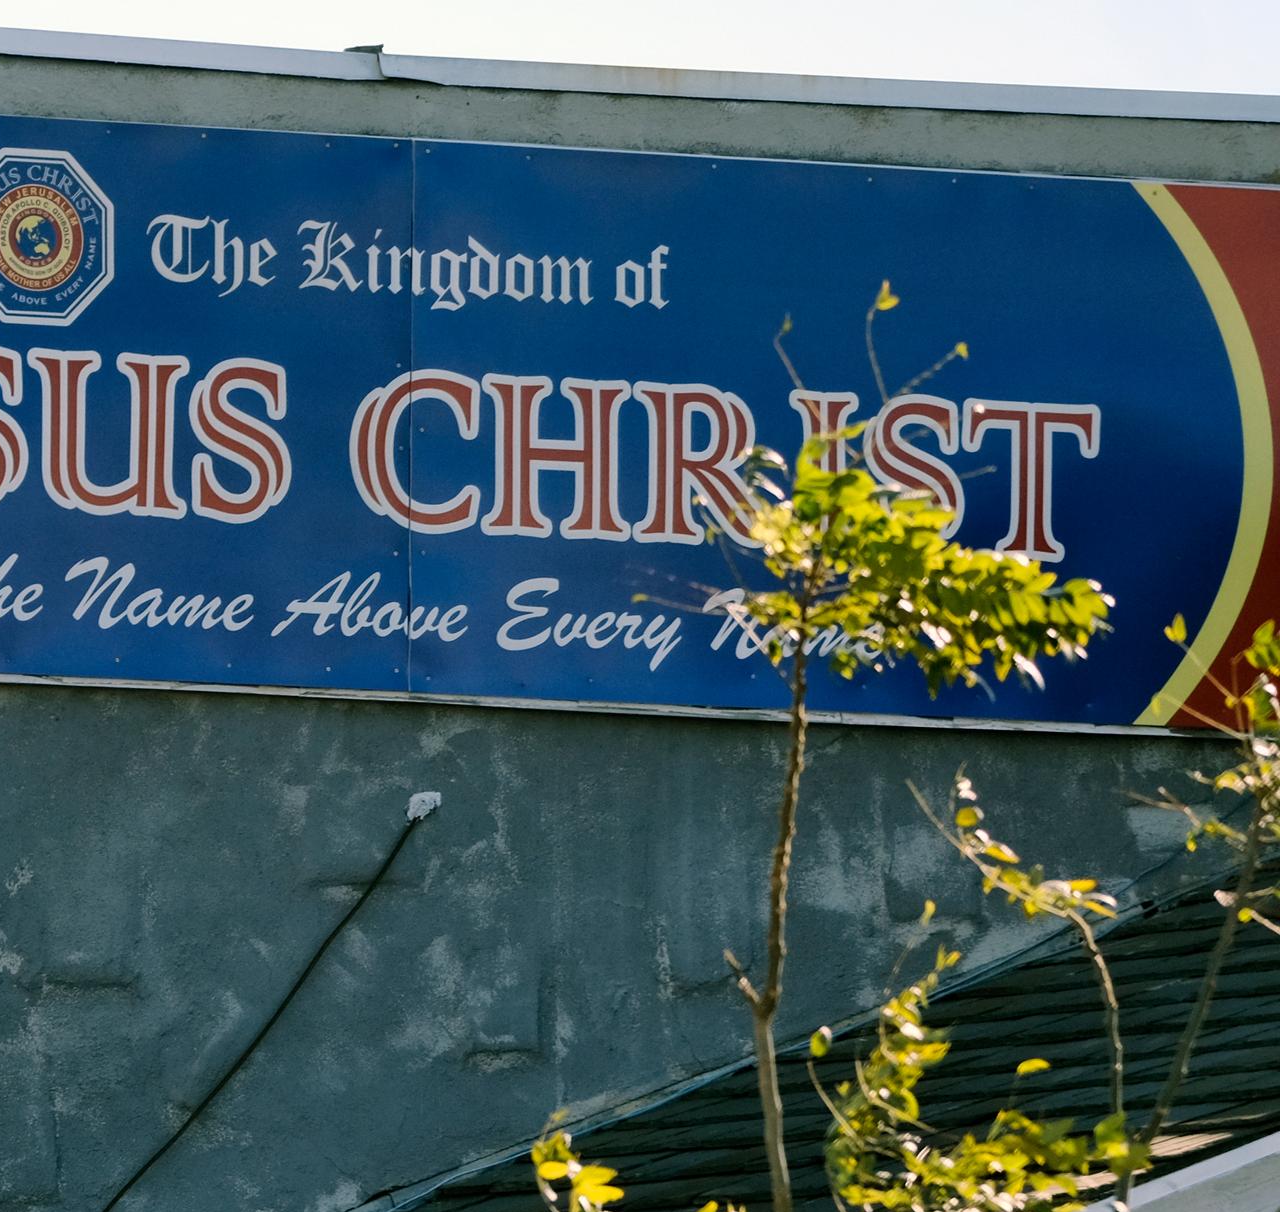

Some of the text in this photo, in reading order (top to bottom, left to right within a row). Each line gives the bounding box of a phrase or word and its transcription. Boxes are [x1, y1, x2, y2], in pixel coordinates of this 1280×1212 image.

[0, 212, 12, 247] PASTOR
[11, 198, 41, 215] APOLLO
[15, 186, 80, 227] JERUSALEM
[26, 164, 99, 226] CHRIST
[7, 270, 41, 288] MOTHER
[42, 278, 53, 287] OF
[53, 272, 65, 284] US
[63, 258, 77, 276] ALL
[11, 292, 48, 305] ABOVE
[55, 275, 85, 302] EVERY
[85, 236, 97, 270] NAME
[146, 213, 670, 311] The Kingdom of
[63, 556, 255, 633] Name
[270, 570, 469, 643] Above
[496, 577, 683, 672] Every
